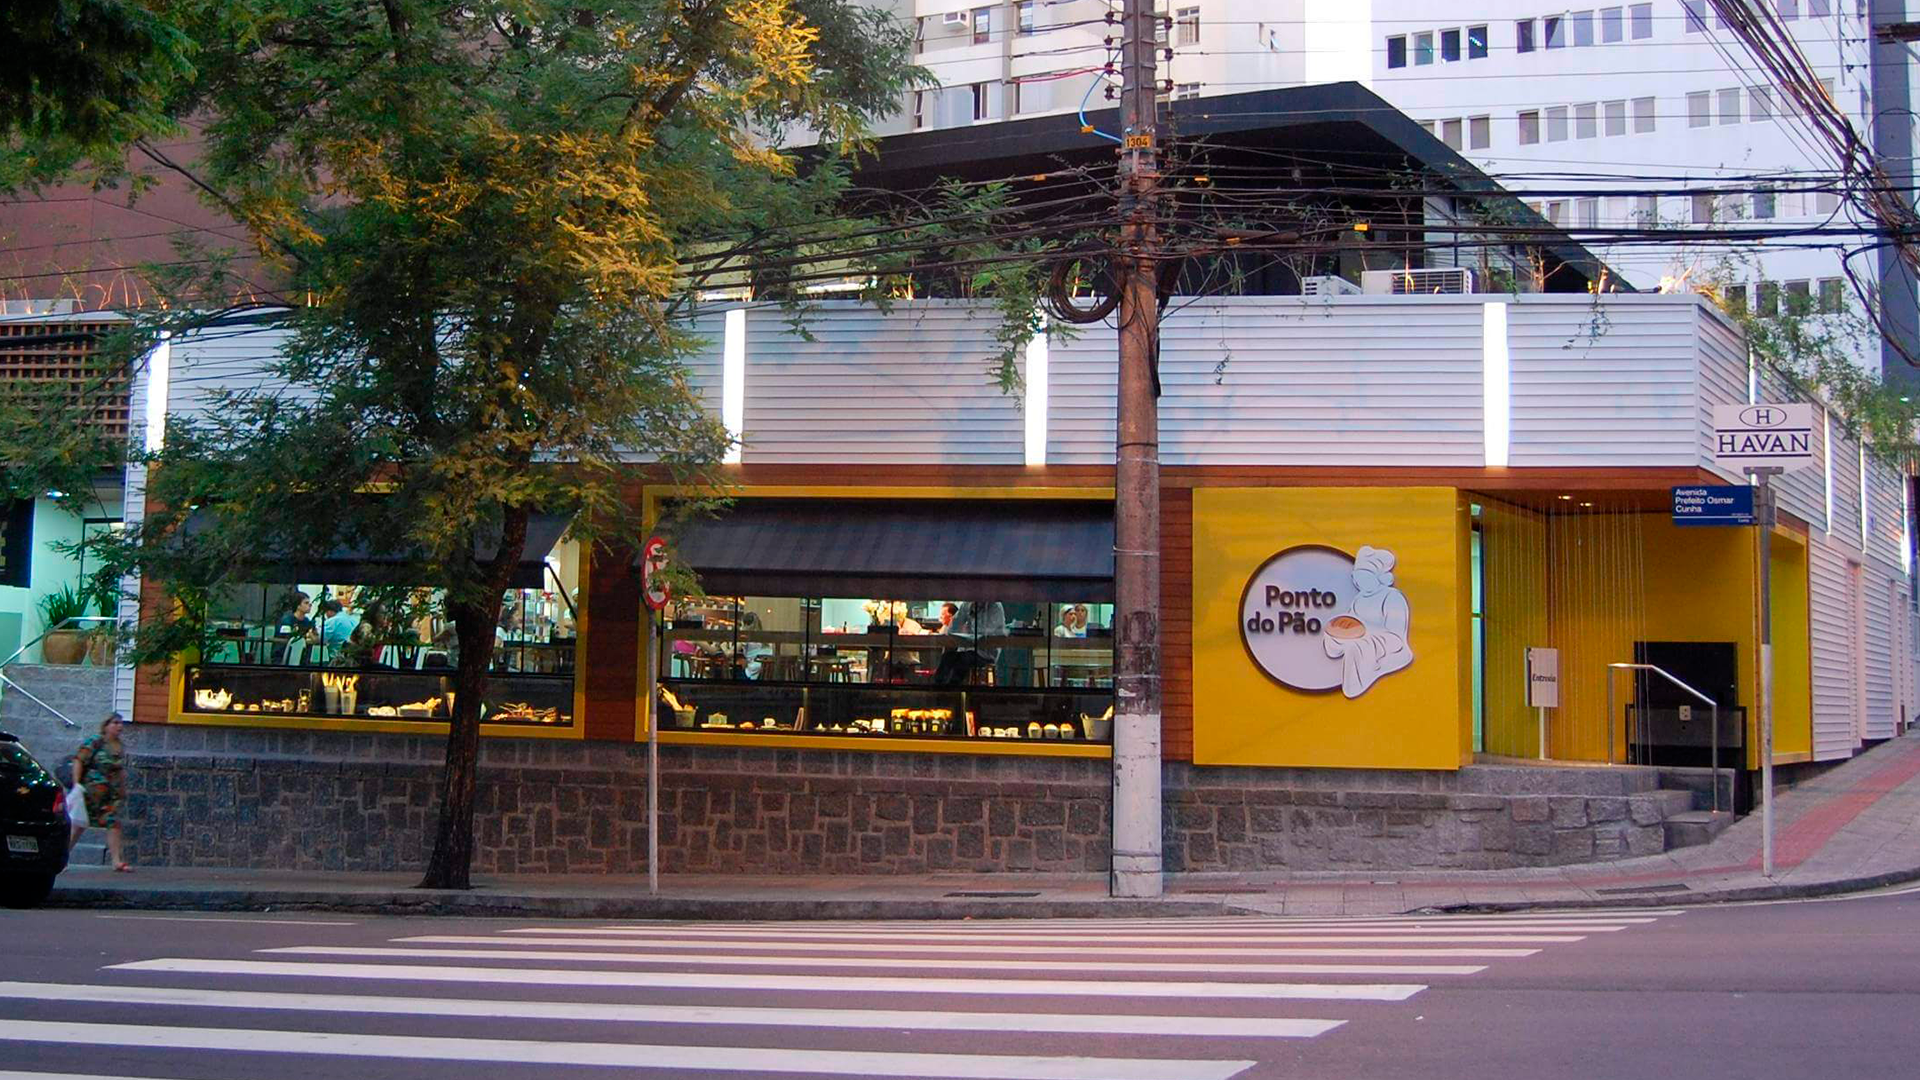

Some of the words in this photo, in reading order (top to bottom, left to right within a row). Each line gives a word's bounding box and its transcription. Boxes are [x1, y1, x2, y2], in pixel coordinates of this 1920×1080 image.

[1755, 409, 1771, 425] H
[1717, 433, 1810, 453] HAVAN
[1675, 488, 1708, 496] Avenida
[1675, 496, 1706, 505] Prefeito
[1707, 496, 1735, 505] Osmar
[1675, 505, 1703, 513] Cunha
[1265, 584, 1338, 609] Ponto
[1247, 611, 1275, 635] do
[1278, 611, 1322, 635] Pão
